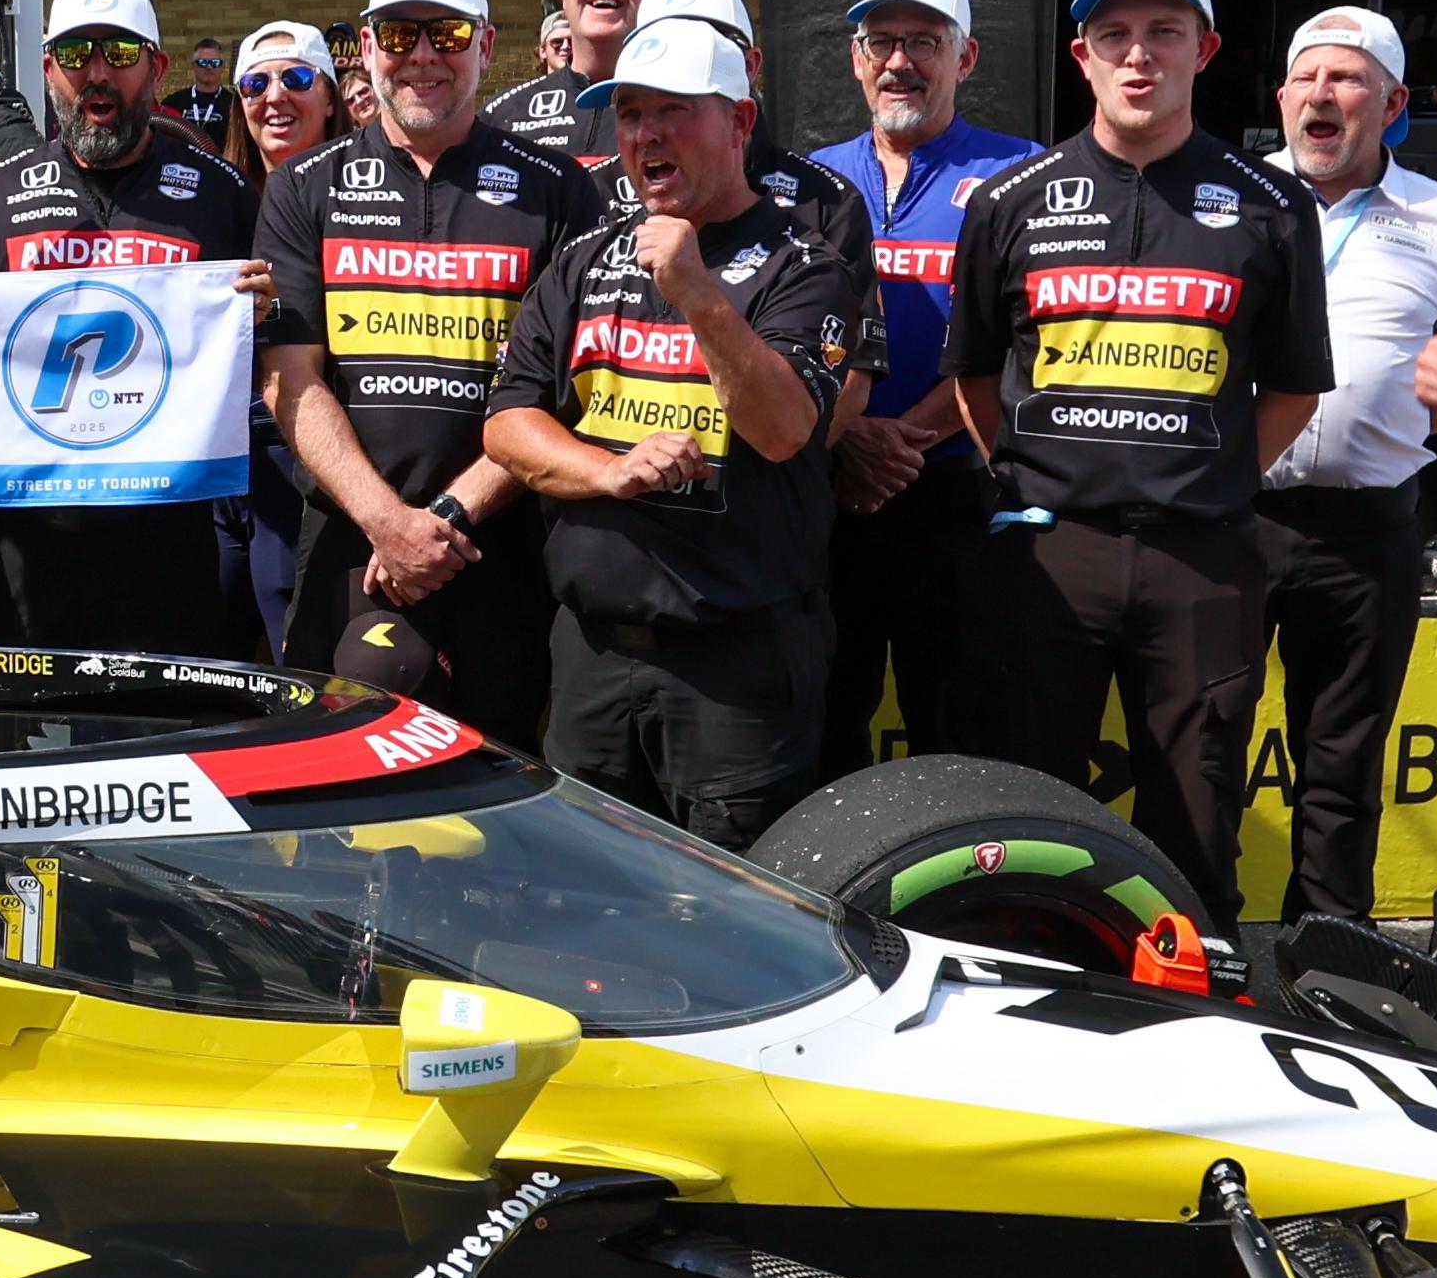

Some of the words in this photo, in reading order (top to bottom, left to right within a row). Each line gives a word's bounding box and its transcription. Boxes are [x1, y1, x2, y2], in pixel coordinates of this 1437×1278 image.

[511, 115, 575, 132] HONDA
[477, 179, 519, 191] INDYCAR
[989, 151, 1064, 201] Firestone
[1224, 152, 1290, 208] Firestone
[7, 187, 78, 205] HONDA
[329, 187, 404, 203] HONDA
[11, 207, 78, 224] GROUP1001
[331, 211, 401, 227] GROUP1001
[1026, 213, 1111, 230] HONDA
[21, 237, 188, 269] ANDRETTI
[1029, 239, 1106, 255] GROUP1001
[336, 245, 518, 284] ANDRETTI
[1037, 273, 1232, 314] ANDRETTI
[367, 310, 508, 344] GAINBRIDGE
[577, 323, 696, 365] ANDRET
[1066, 340, 1218, 375] GAINBRIDGE
[113, 392, 144, 404] NTT
[360, 375, 484, 401] GROUP1001
[590, 391, 724, 435] GAINBRIDGE
[1051, 405, 1189, 435] GROUP1001
[70, 423, 106, 433] 2025
[7, 479, 72, 492] STREETS
[78, 478, 95, 490] OF
[101, 476, 170, 489] TORONTO
[179, 665, 245, 689] Delaware
[248, 675, 274, 694] Life
[421, 1055, 505, 1079] SIEMENS
